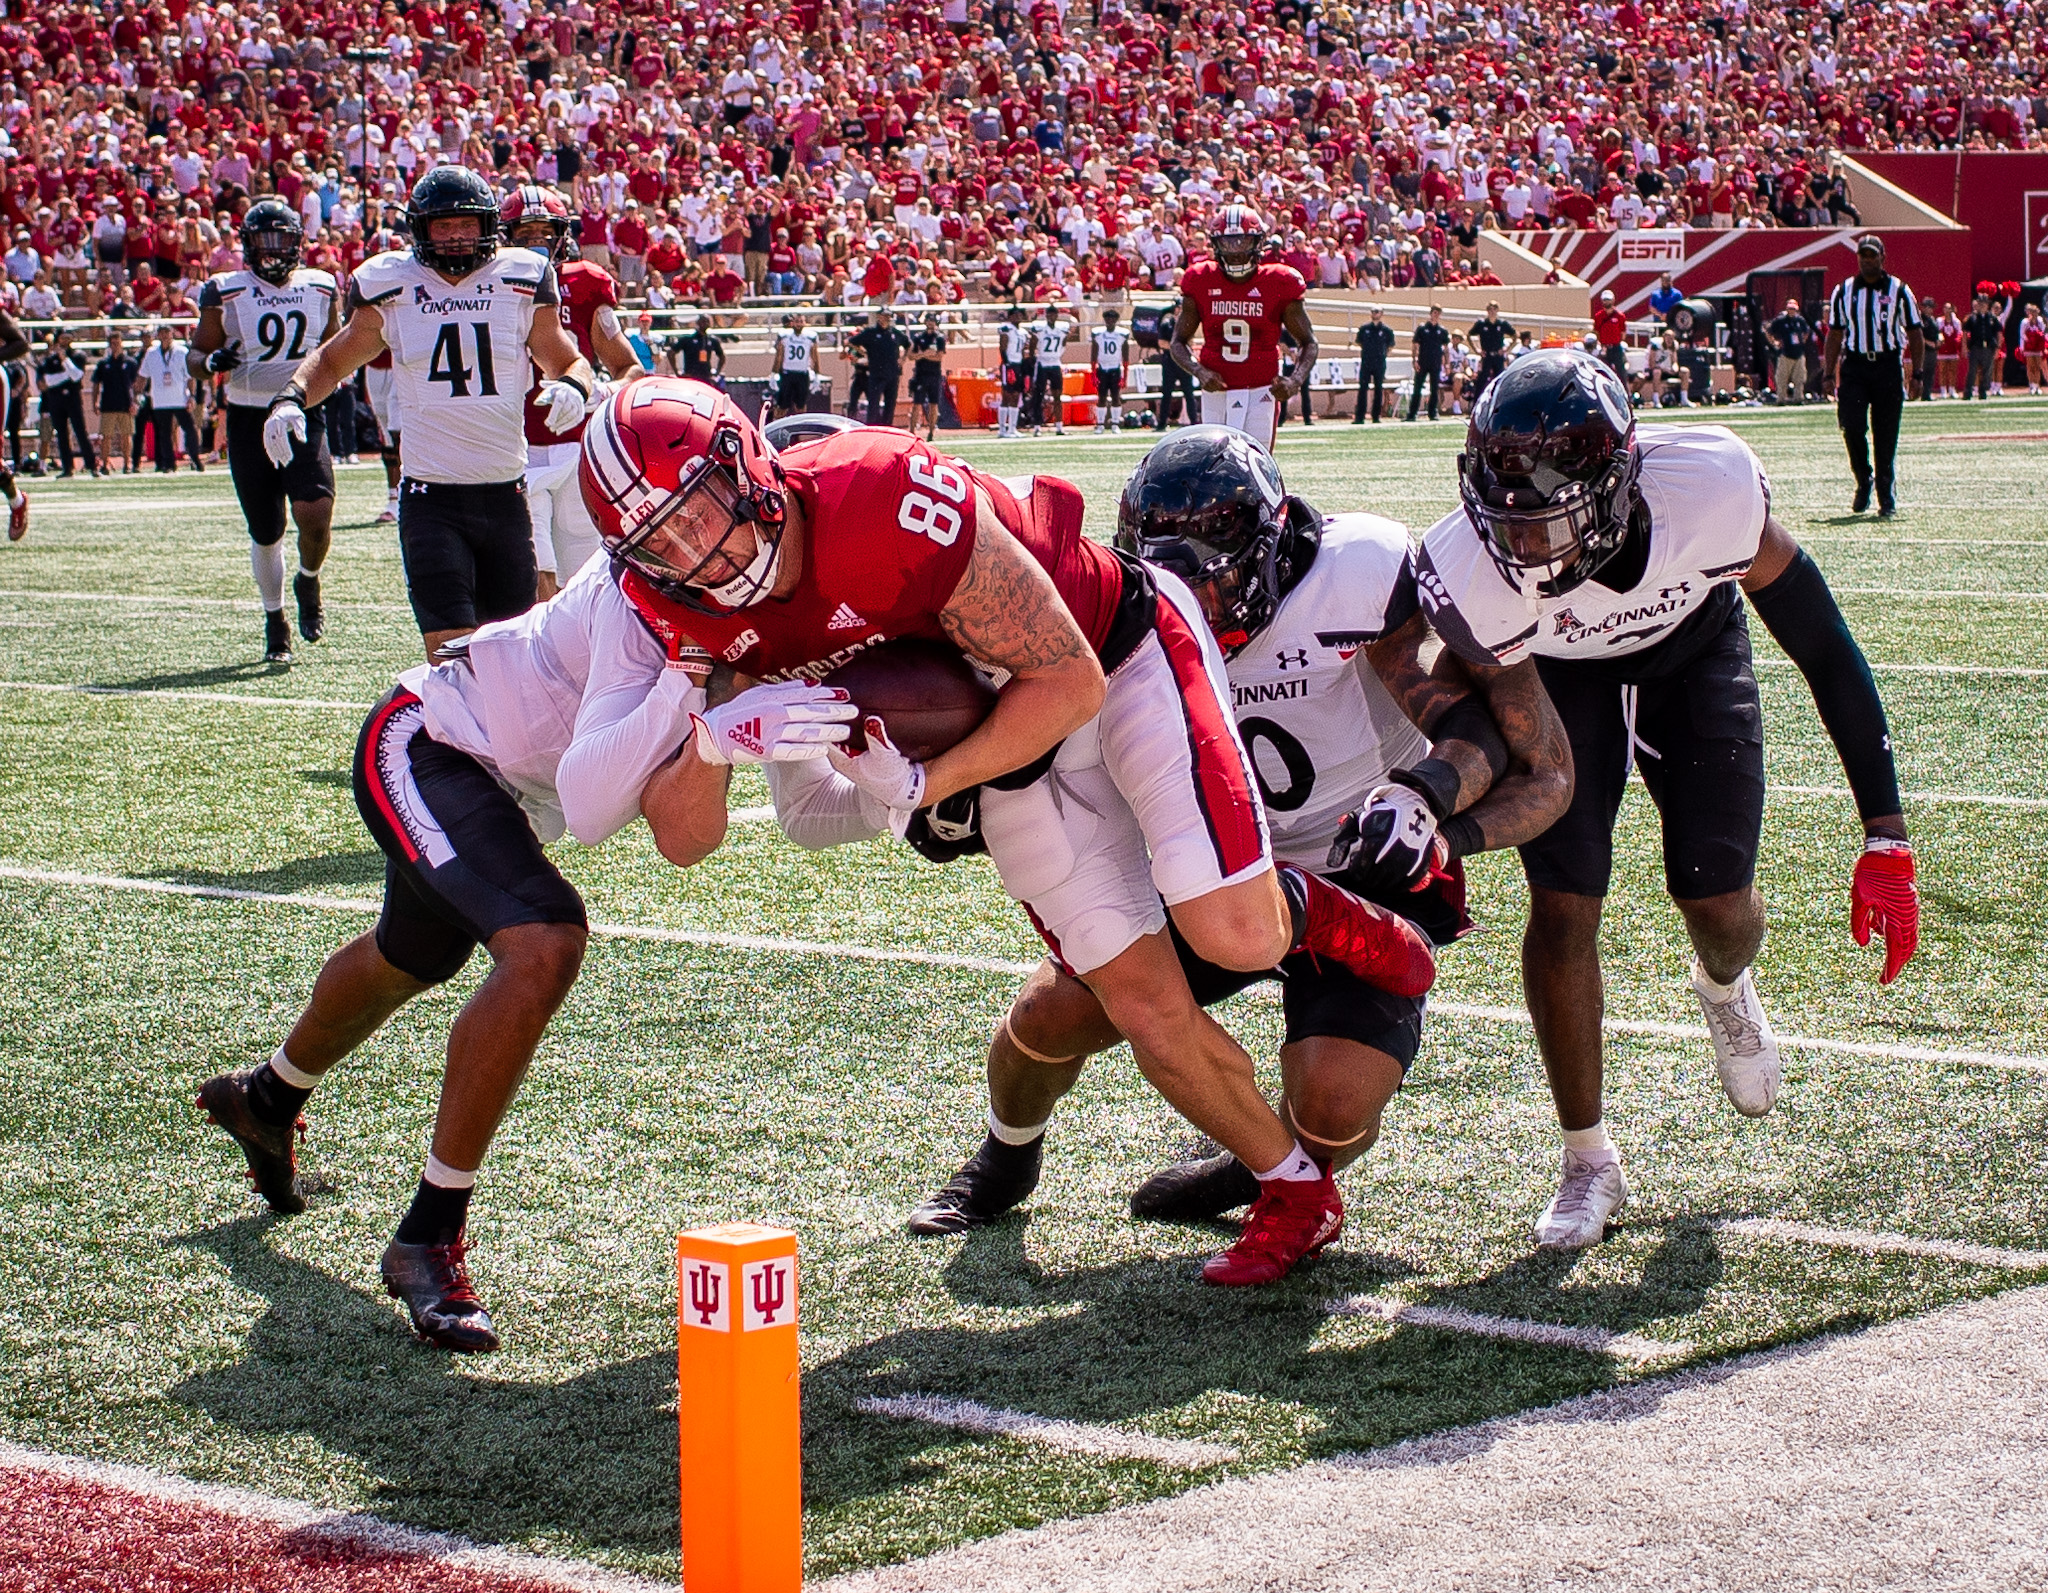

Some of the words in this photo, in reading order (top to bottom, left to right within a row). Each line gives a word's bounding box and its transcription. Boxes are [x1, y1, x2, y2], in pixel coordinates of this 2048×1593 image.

[1622, 208, 1633, 220] 15
[1621, 239, 1682, 259] ESPN
[1156, 253, 1173, 270] 12
[257, 295, 303, 308] CINCINNATI
[421, 298, 492, 316] CINCINNATI
[1211, 301, 1263, 317] HOOSIERS
[1880, 311, 1888, 322] C
[257, 309, 308, 362] 92
[1043, 336, 1061, 352] 27
[1221, 318, 1250, 363] 9
[788, 345, 805, 361] 30
[1104, 341, 1117, 354] 10
[428, 321, 500, 398] 41
[898, 454, 967, 547] 86
[725, 580, 748, 596] Ridde
[827, 616, 867, 630] adidas
[1565, 599, 1687, 644] CINCINNATI
[728, 728, 765, 755] adidas
[689, 1263, 722, 1326] IU
[751, 1262, 787, 1325] IU
